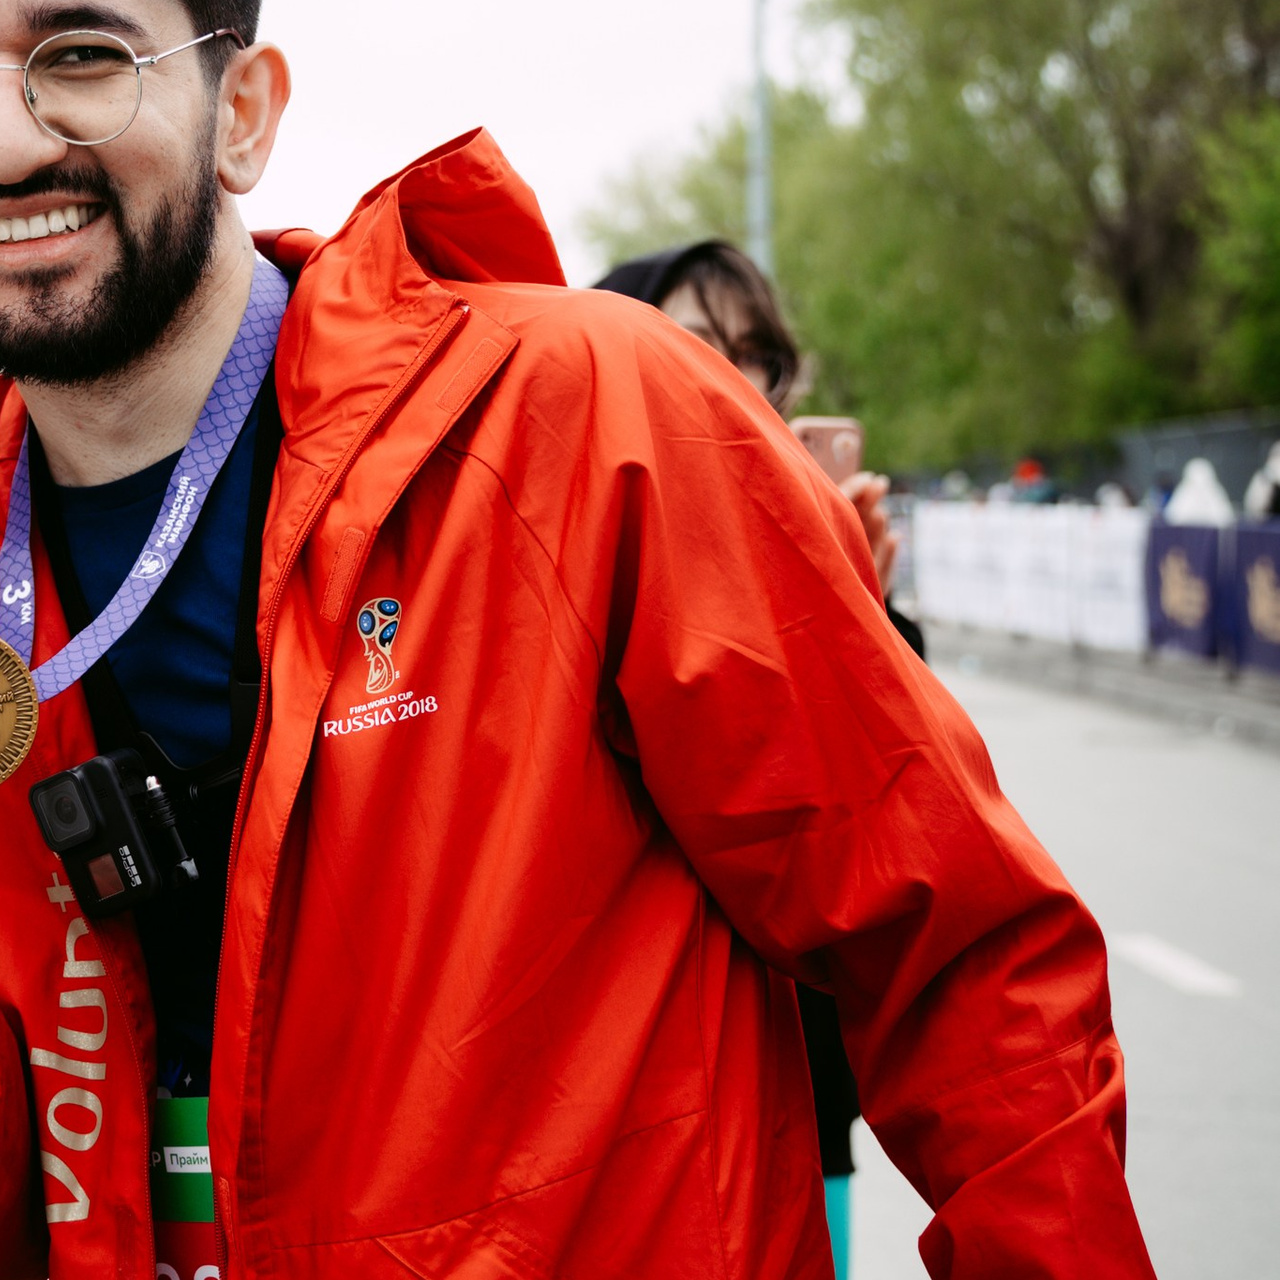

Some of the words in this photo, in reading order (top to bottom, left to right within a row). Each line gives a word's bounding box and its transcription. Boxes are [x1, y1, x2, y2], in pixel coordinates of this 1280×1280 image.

[155, 476, 192, 548] КАЗАНСКИЙ
[167, 486, 198, 543] МАРАФОН
[2, 580, 31, 605] 3
[323, 707, 397, 737] RUSSIA
[397, 695, 438, 721] 2018
[349, 704, 368, 715] FIFA
[367, 695, 397, 710] WORLD
[397, 690, 414, 702] CUP
[119, 847, 138, 887] GoPro
[30, 851, 109, 1224] Volunt
[169, 1152, 208, 1168] Прайм
